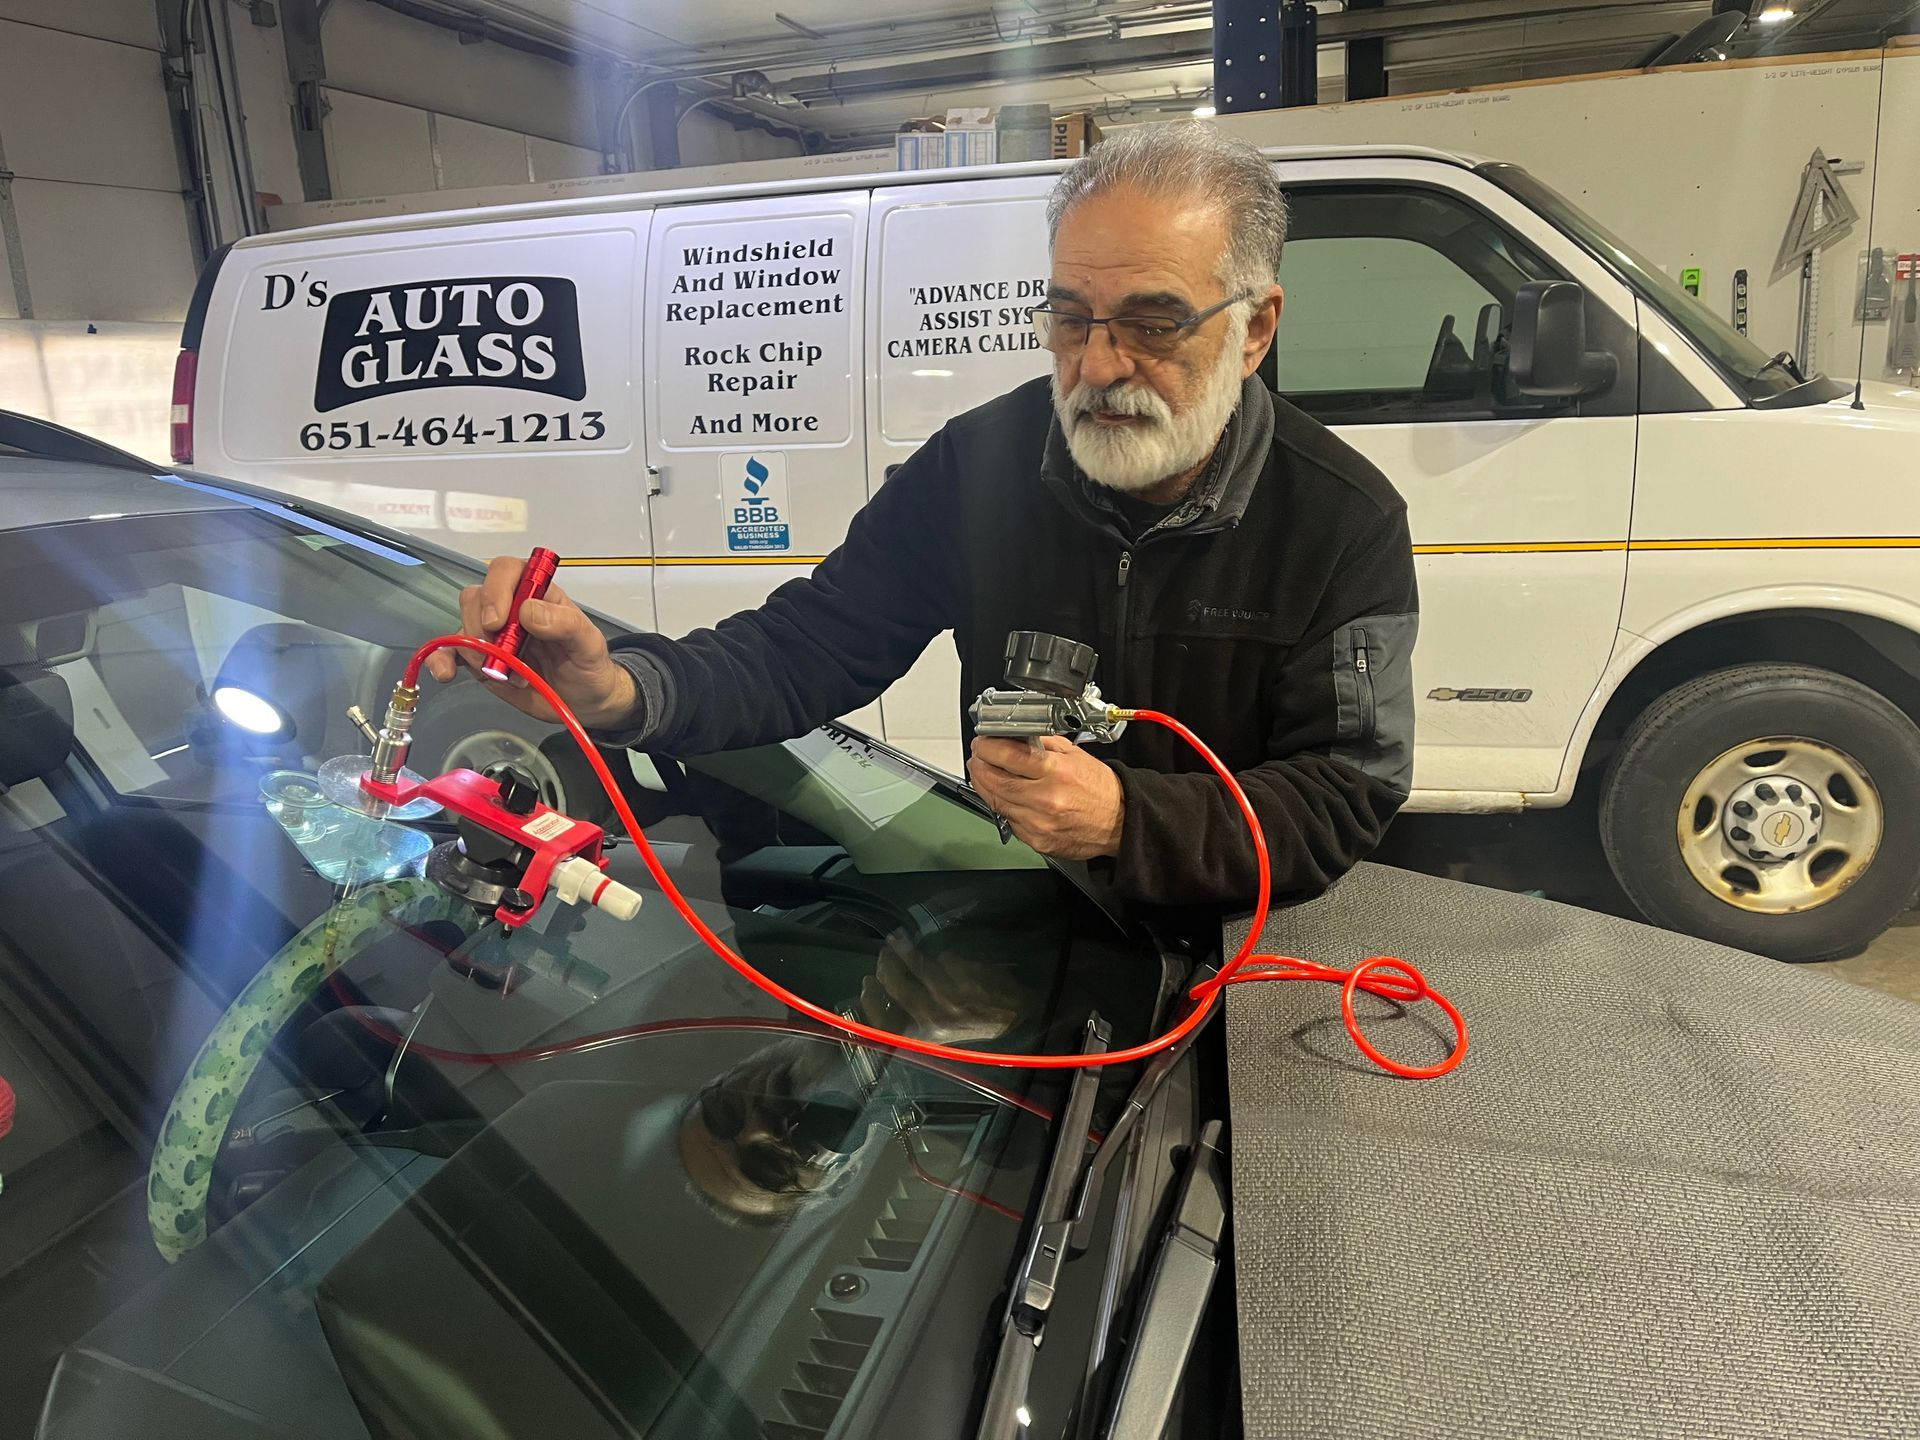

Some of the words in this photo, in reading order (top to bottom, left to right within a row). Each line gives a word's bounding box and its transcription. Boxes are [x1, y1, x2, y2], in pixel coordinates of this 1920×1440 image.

[682, 238, 834, 266] Windshield
[260, 270, 328, 311] D's
[672, 272, 724, 294] And
[734, 266, 841, 290] Window
[909, 281, 1010, 306] "ADVANCE
[1016, 279, 1050, 298] DR
[354, 282, 544, 338] AUTO
[666, 293, 844, 326] Replacement
[919, 310, 992, 332] ASSIST
[998, 306, 1036, 326] SYS
[684, 344, 751, 366] Rock
[759, 340, 822, 367] Chip
[888, 336, 972, 358] CAMERA
[978, 332, 1040, 353] CALIB
[340, 332, 557, 390] GLASS
[708, 369, 798, 396] Repair
[299, 410, 606, 452] 651-464-1213
[690, 413, 742, 435] And
[752, 412, 820, 433] More
[734, 508, 778, 523] BBB
[1460, 688, 1532, 702] 2500
